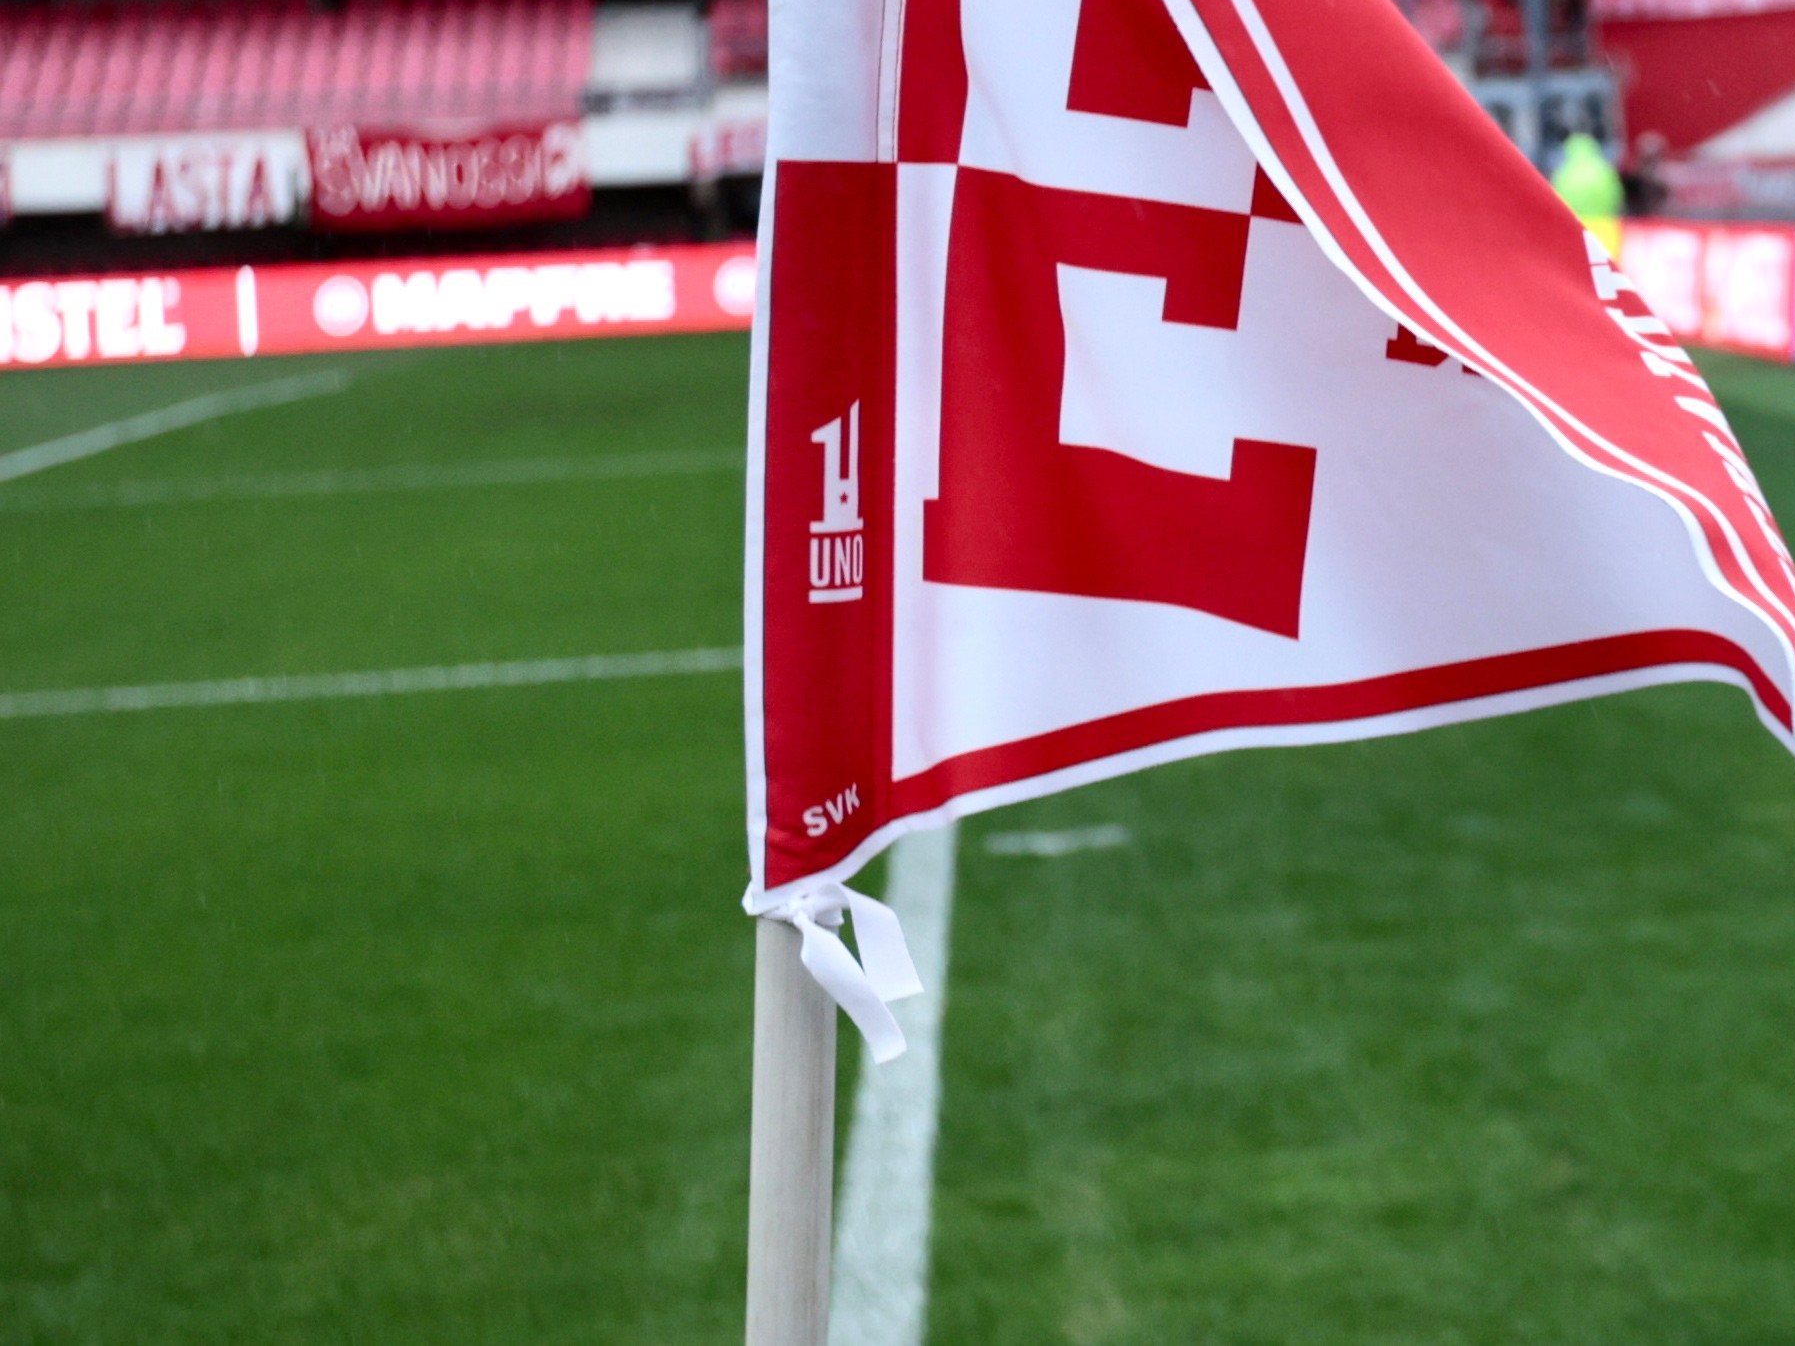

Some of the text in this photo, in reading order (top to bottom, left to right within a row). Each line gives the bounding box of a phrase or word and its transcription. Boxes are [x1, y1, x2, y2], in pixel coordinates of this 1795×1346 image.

[0, 275, 187, 364] STEL
[809, 533, 863, 589] UNO
[802, 782, 861, 838] SVK
